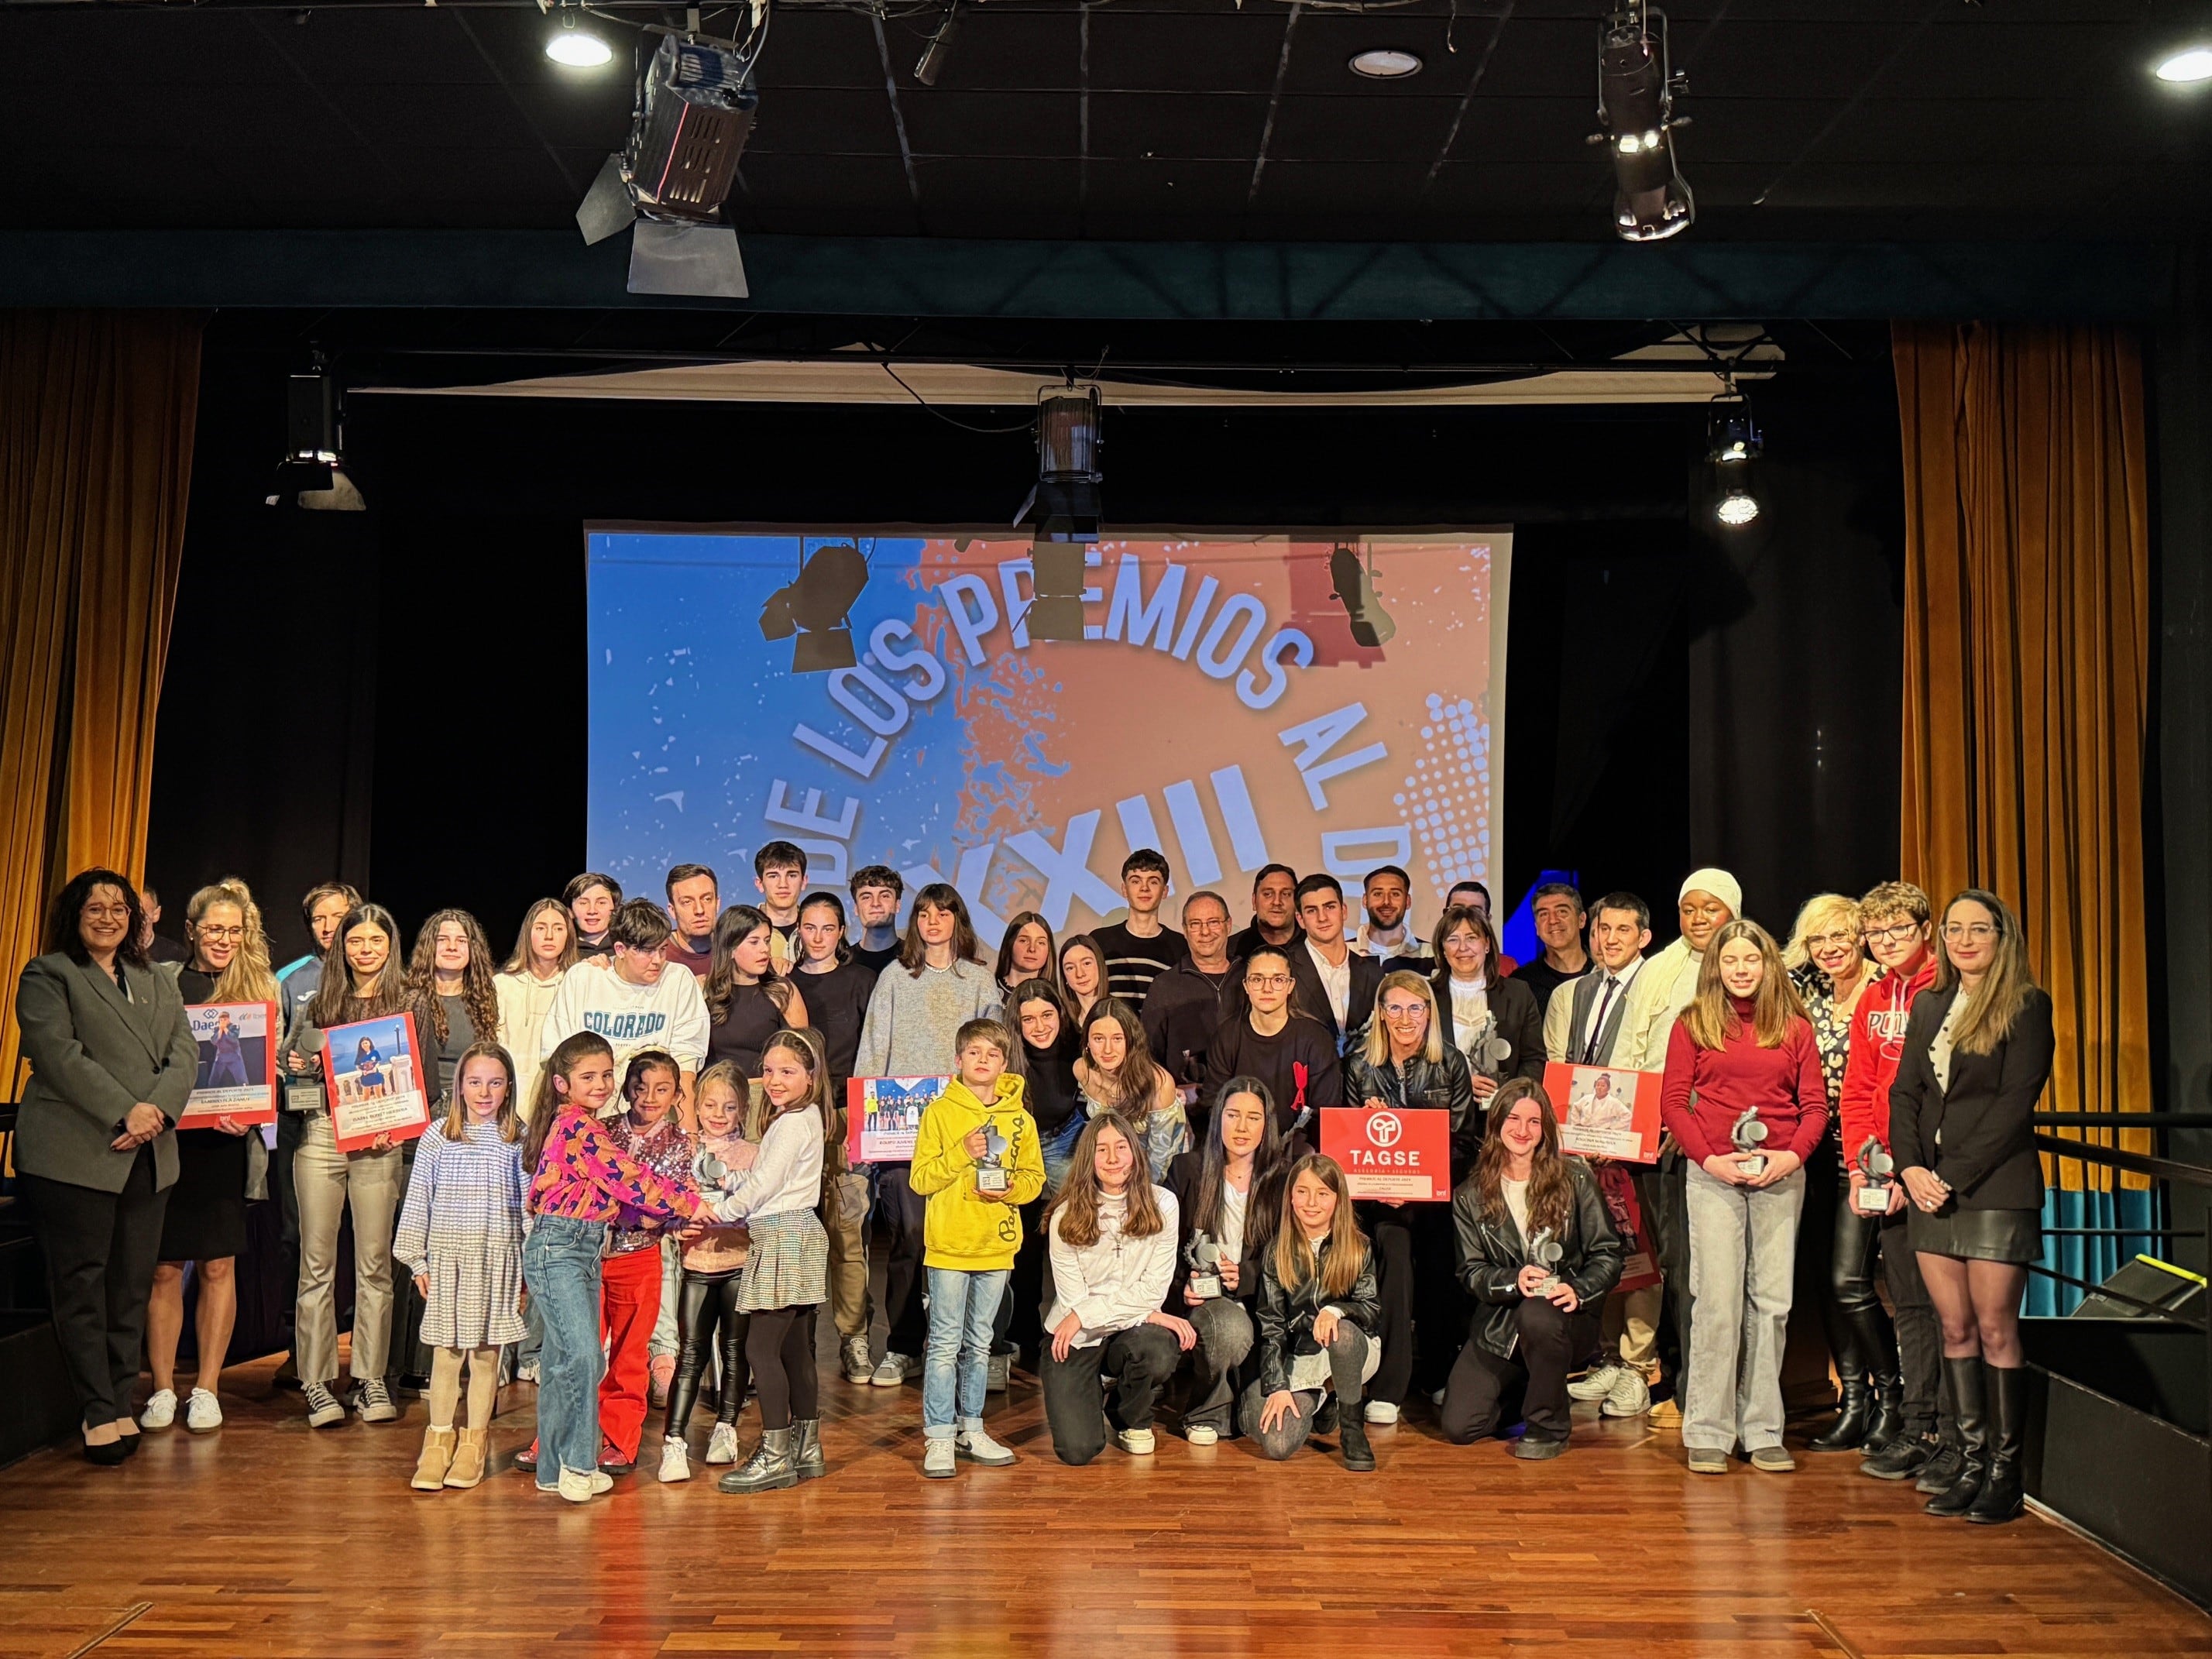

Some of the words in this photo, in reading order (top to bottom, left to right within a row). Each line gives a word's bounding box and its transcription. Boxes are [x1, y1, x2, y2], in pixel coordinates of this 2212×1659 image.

[792, 619, 946, 778] LOS
[1278, 702, 1388, 811] AL
[583, 1011, 666, 1039] COLORADO
[1350, 1149, 1420, 1166] TAGSE
